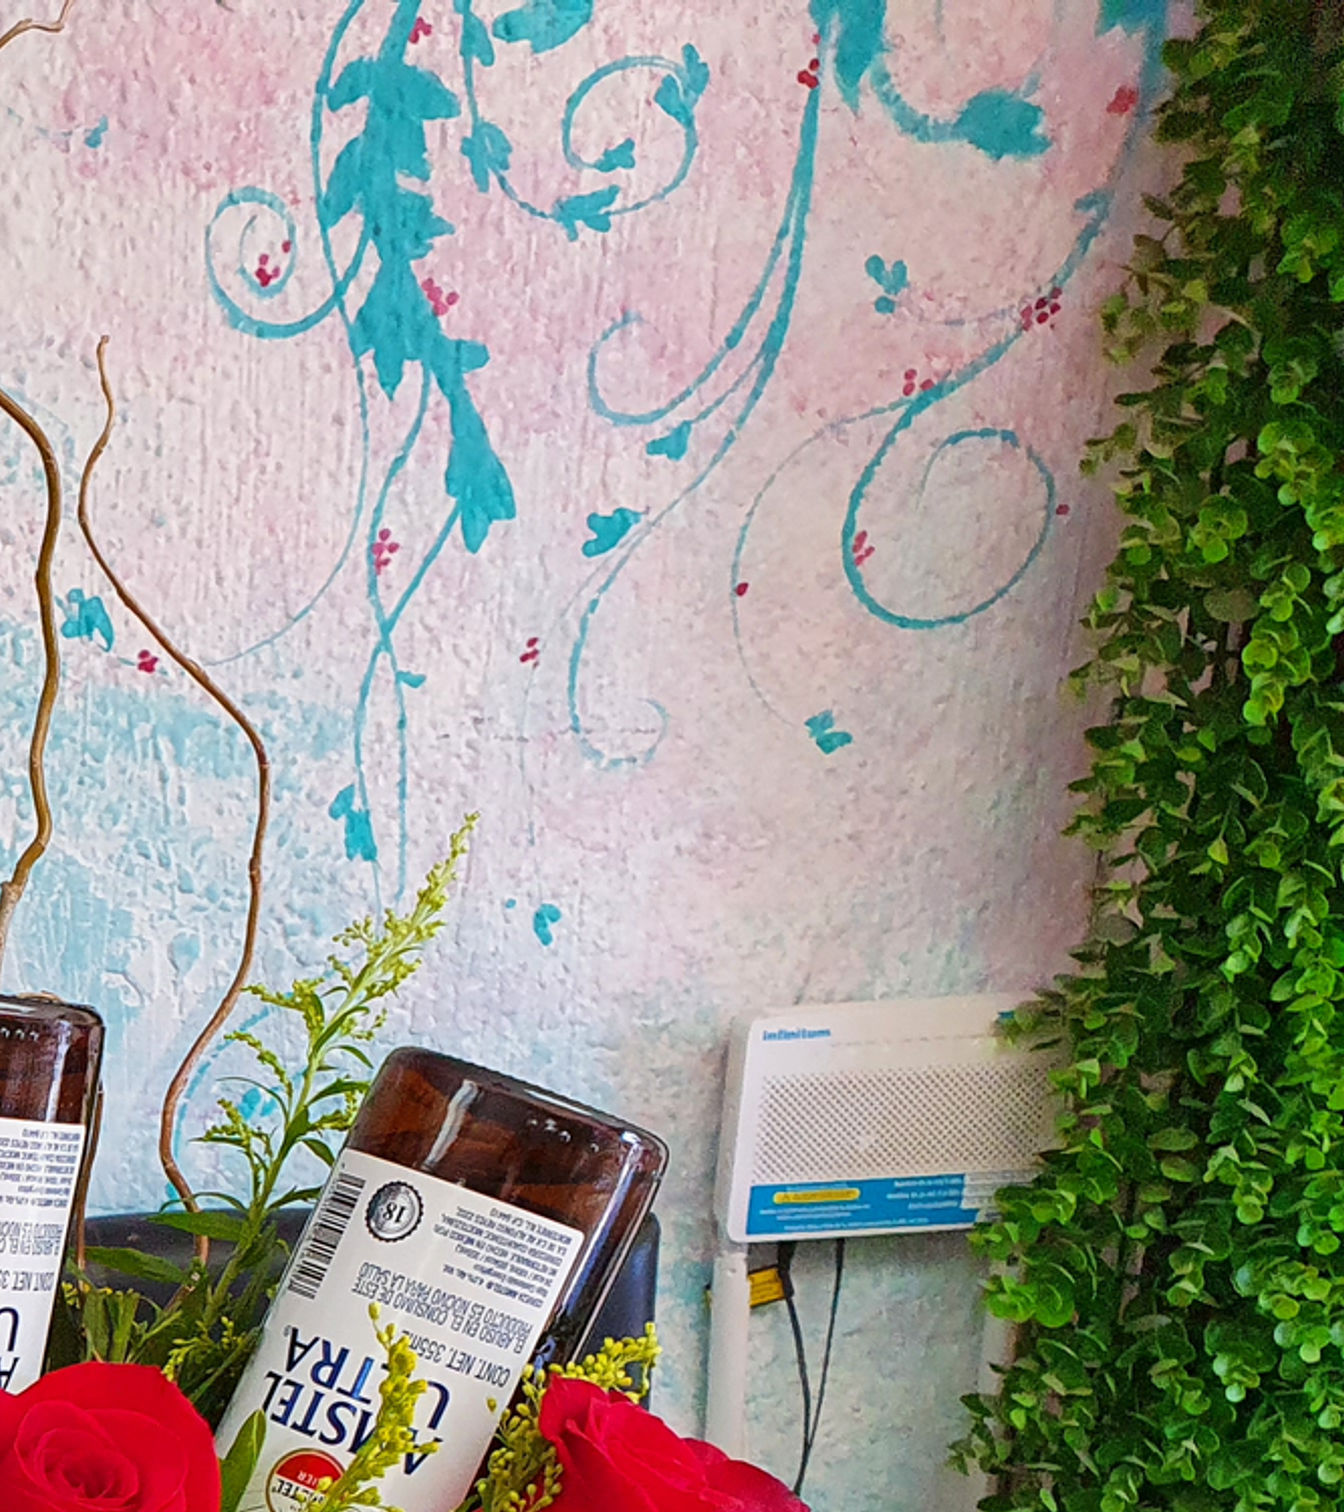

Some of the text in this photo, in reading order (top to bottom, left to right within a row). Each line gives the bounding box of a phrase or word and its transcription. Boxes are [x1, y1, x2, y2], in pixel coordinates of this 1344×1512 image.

[351, 1276, 379, 1299] ESTE
[376, 1285, 394, 1305] DE
[358, 1261, 533, 1340] PRODUCTO ES NOCIVO PARA LA SALUD
[392, 1292, 448, 1326] CONSUMO
[450, 1312, 464, 1332] EL
[461, 1318, 480, 1338] EN
[479, 1324, 514, 1349] ABUSO
[445, 1347, 475, 1374] NET.
[474, 1358, 511, 1388] CONT.
